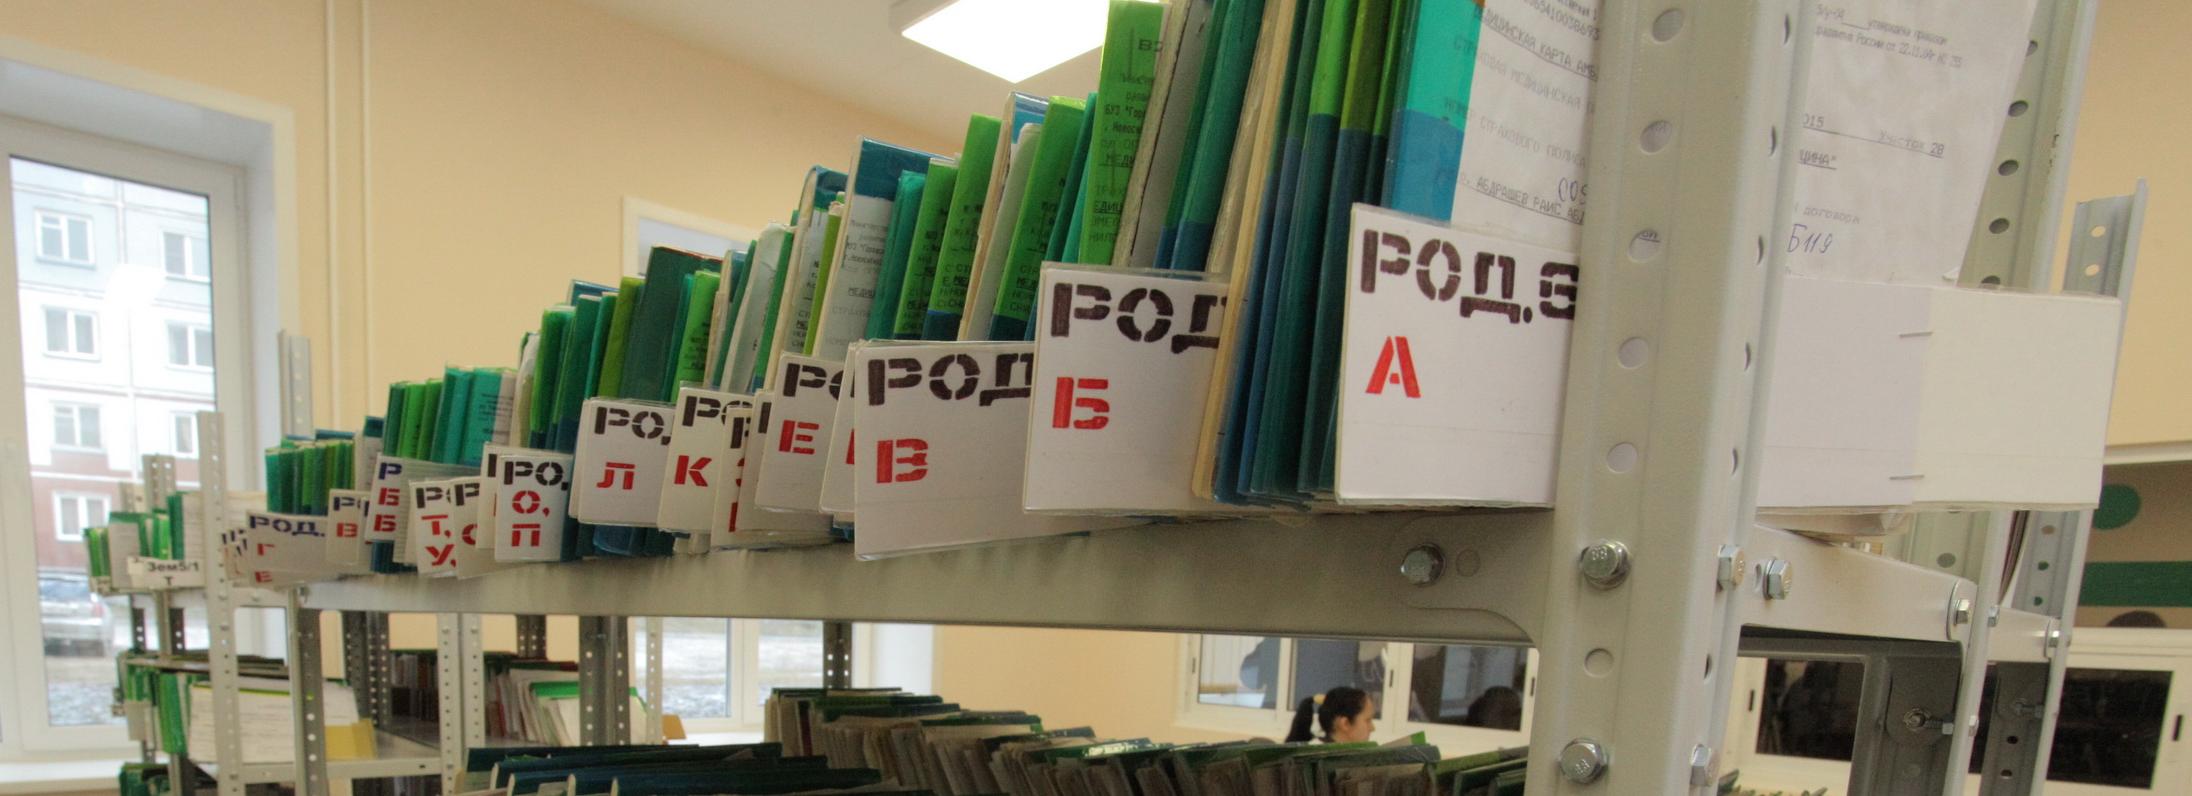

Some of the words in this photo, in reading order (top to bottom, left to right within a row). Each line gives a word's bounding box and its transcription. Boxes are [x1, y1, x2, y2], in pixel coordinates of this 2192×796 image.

[1540, 43, 1572, 67] КАРТА
[1365, 335, 1421, 399] А
[1052, 377, 1110, 430] Б
[779, 420, 820, 455] Е
[597, 462, 635, 490] Л
[674, 455, 712, 487] К
[877, 438, 929, 483] В
[511, 523, 540, 547] П
